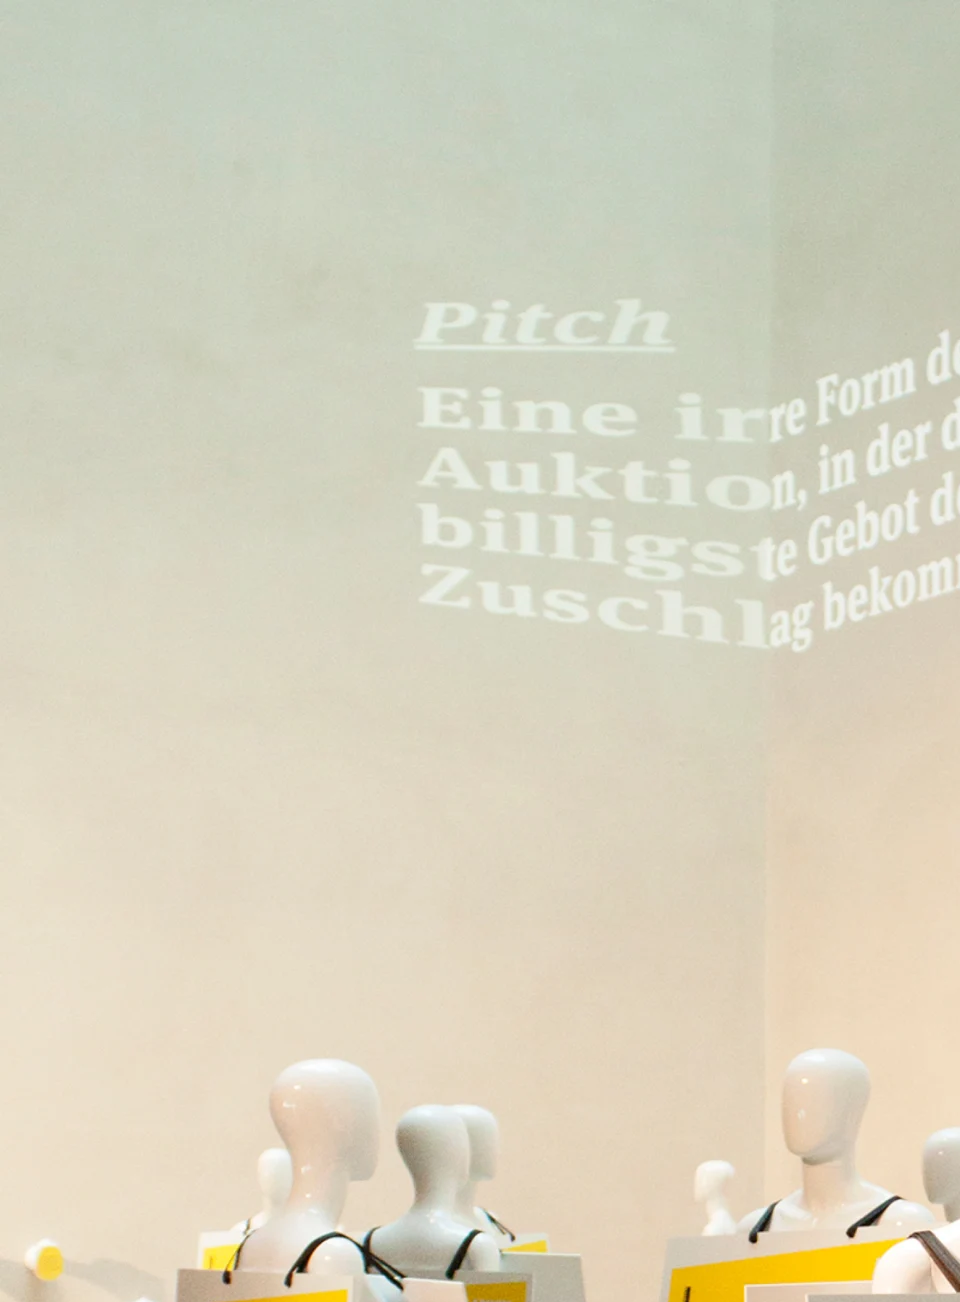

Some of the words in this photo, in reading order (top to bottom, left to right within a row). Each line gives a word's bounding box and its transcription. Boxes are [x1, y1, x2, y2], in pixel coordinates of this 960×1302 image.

[413, 299, 674, 346] Pitch
[417, 386, 638, 436] Eine
[674, 393, 806, 443] irre
[816, 354, 916, 427] Form
[417, 446, 806, 512] Auktion,
[818, 444, 856, 493] in
[866, 420, 933, 478] der
[418, 503, 796, 582] billigste
[807, 486, 919, 567] Gebot
[418, 563, 814, 653] Zuschlag
